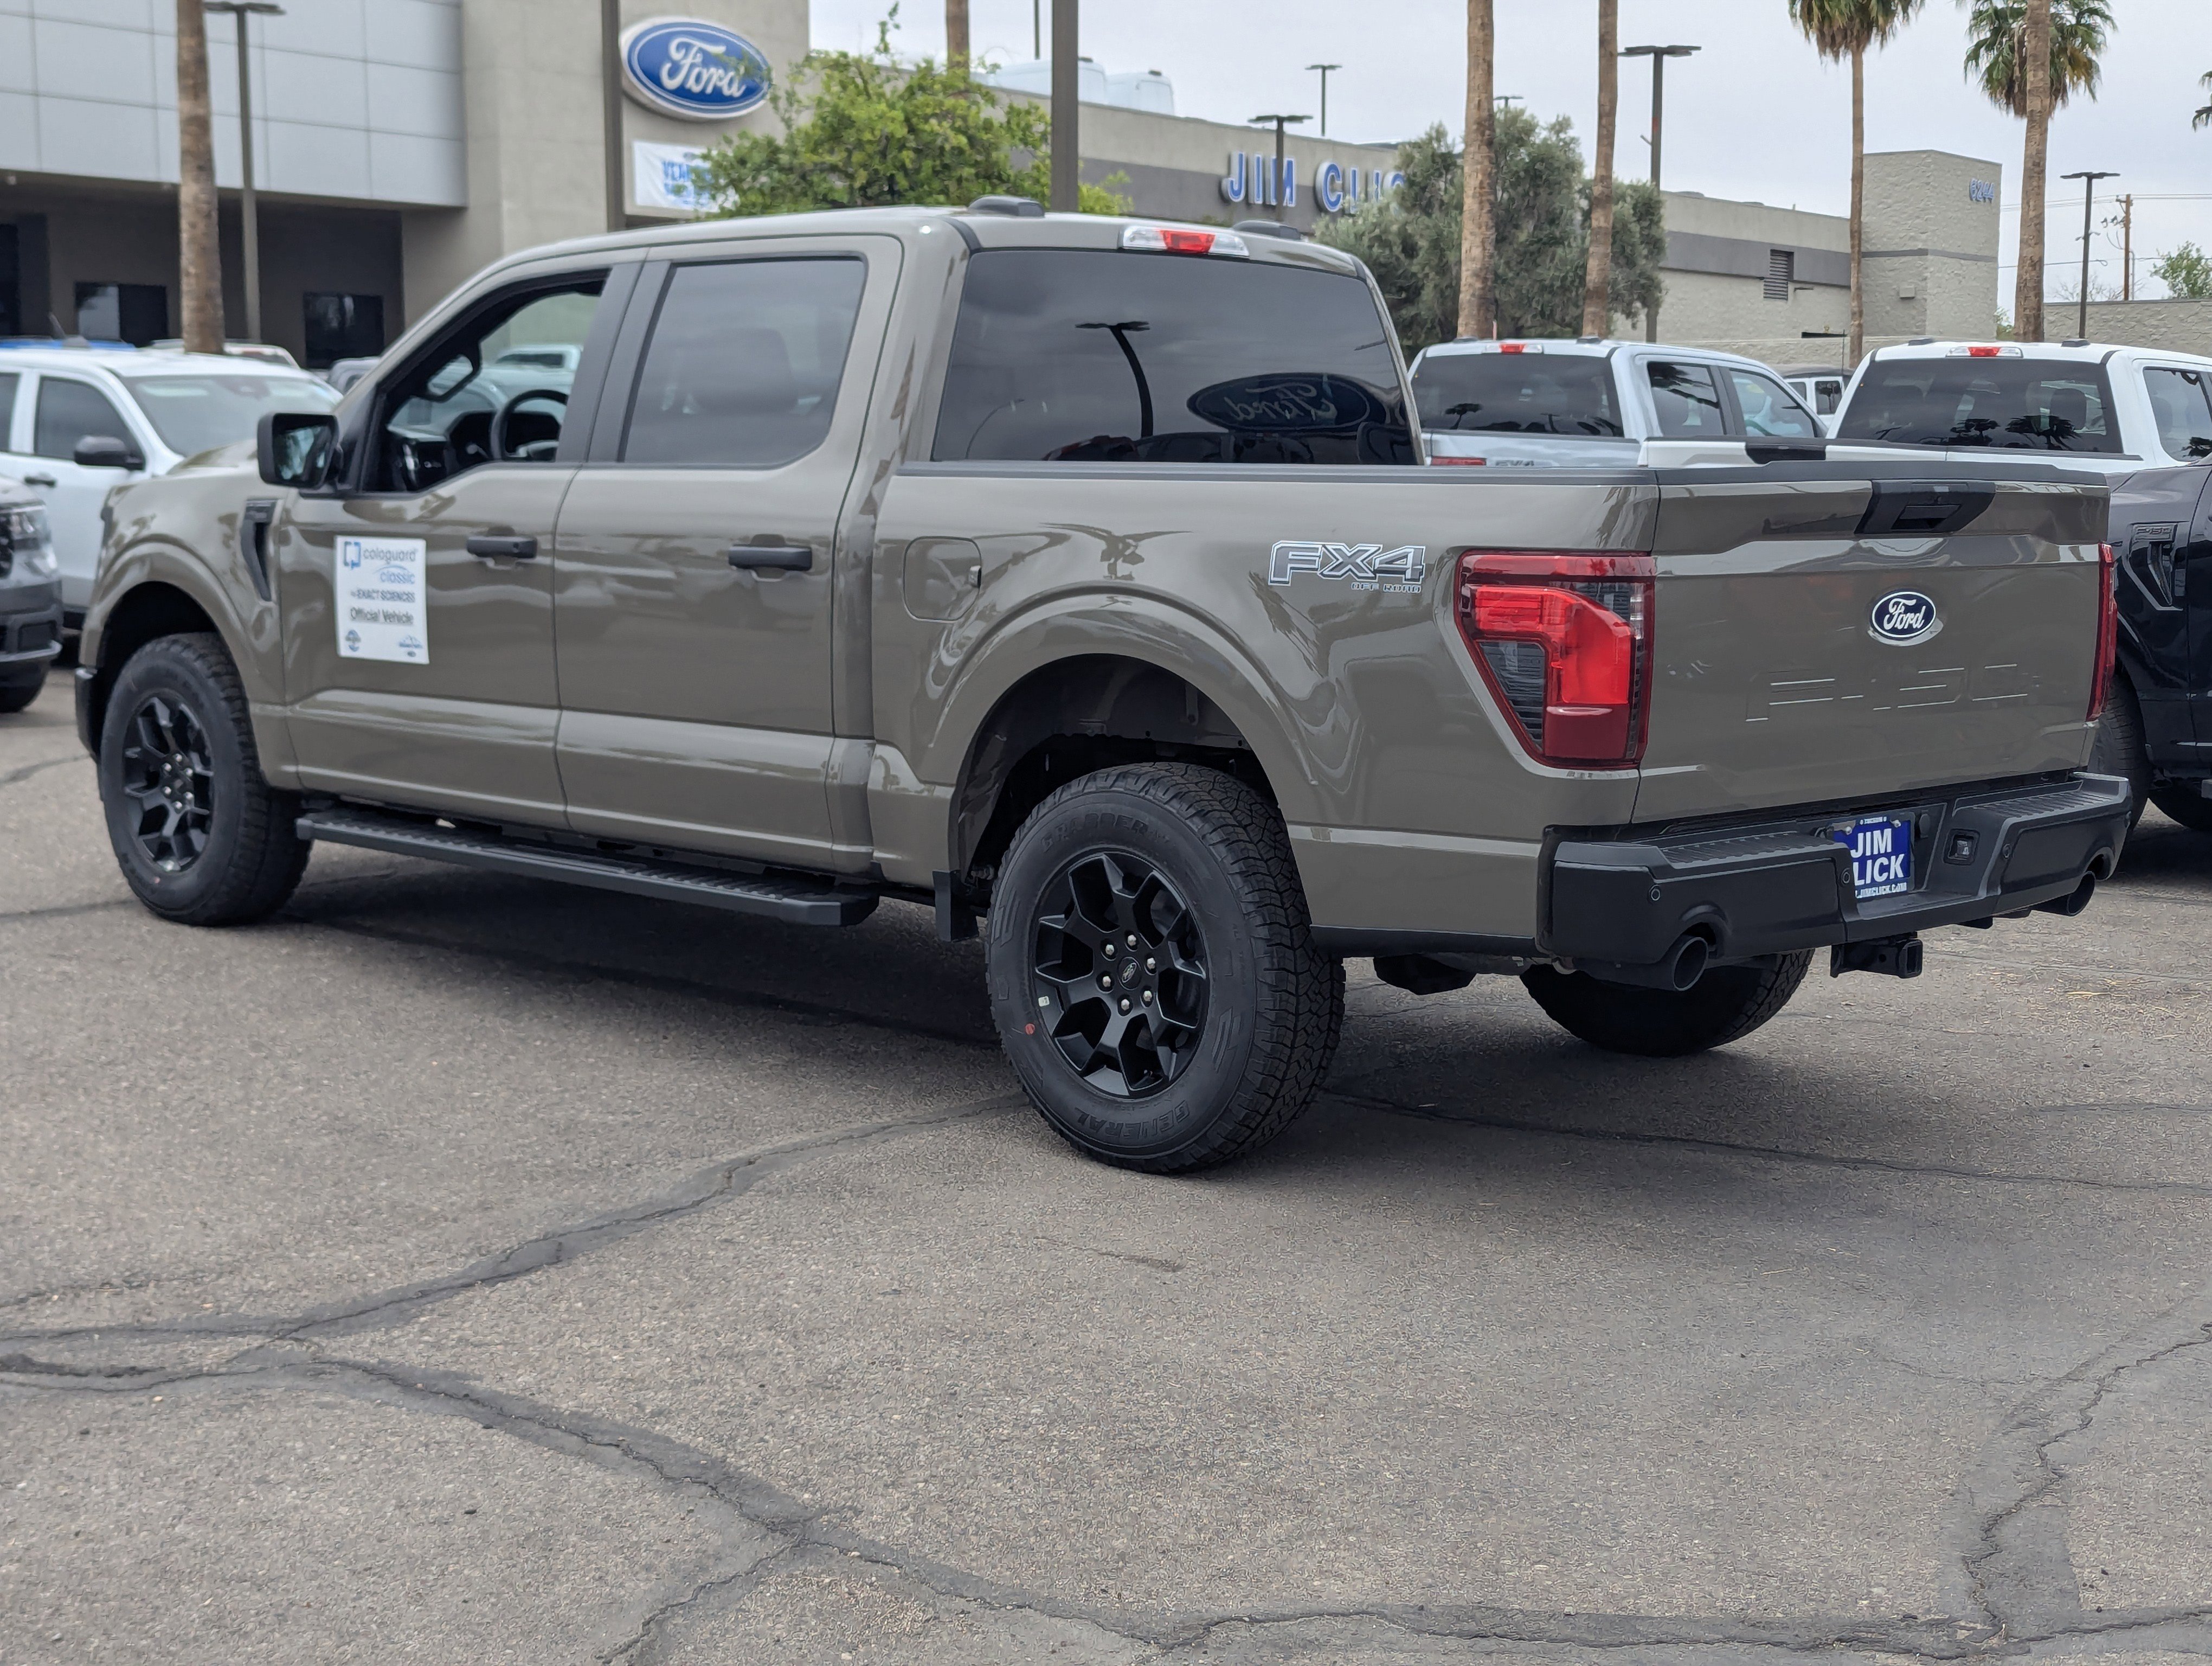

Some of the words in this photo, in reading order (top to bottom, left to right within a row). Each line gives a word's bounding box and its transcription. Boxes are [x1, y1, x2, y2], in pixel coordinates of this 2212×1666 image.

[659, 37, 747, 98] Ford
[1221, 151, 1296, 207] JIM
[1268, 540, 1426, 586] FX4
[1351, 582, 1379, 591] OFF
[1383, 584, 1422, 593] ROAD
[1883, 598, 1926, 630] Ford
[1850, 828, 1892, 858] JIM
[1853, 853, 1905, 886] LICK
